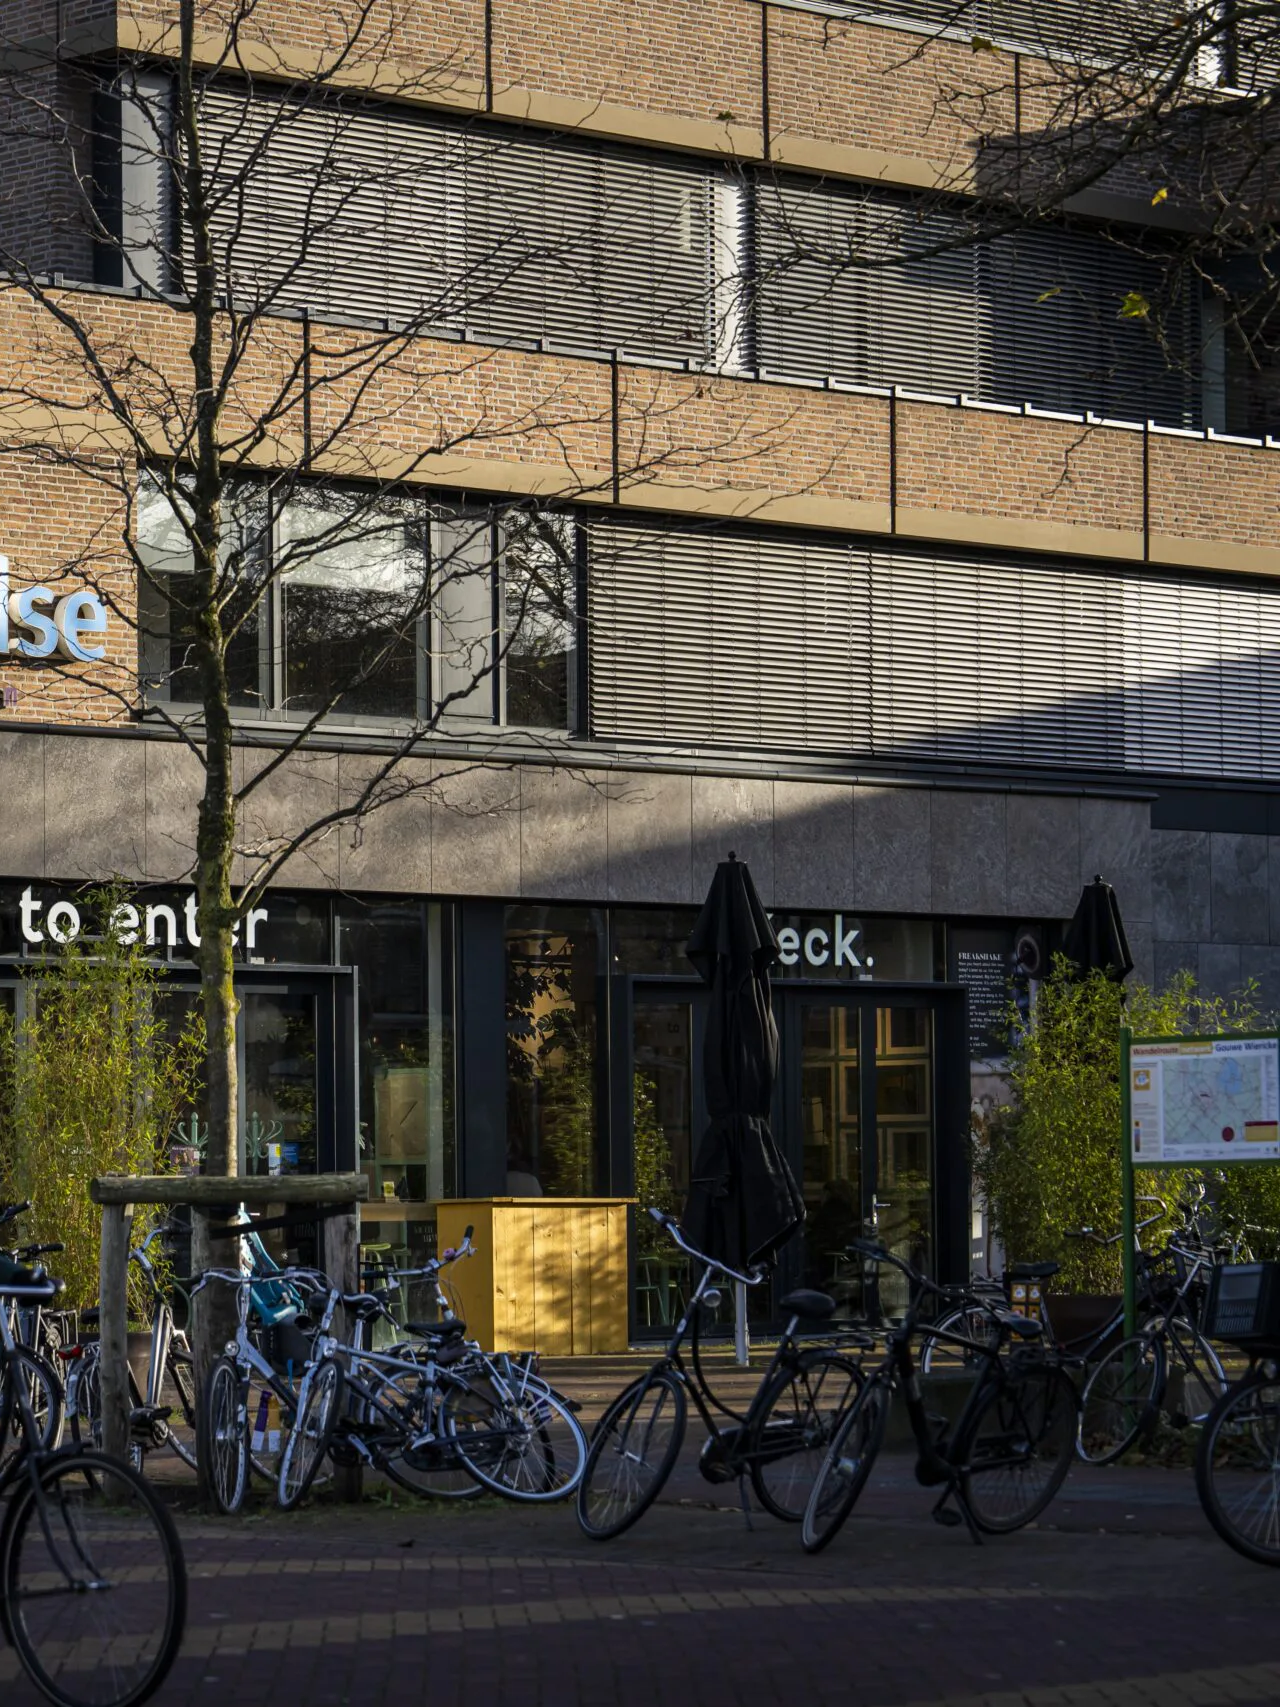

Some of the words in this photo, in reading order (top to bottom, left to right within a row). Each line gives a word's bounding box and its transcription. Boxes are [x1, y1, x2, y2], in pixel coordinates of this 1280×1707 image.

[19, 884, 81, 944] to
[110, 891, 268, 949] entr
[766, 913, 874, 967] eck.
[1215, 1043, 1243, 1052] Gouwe
